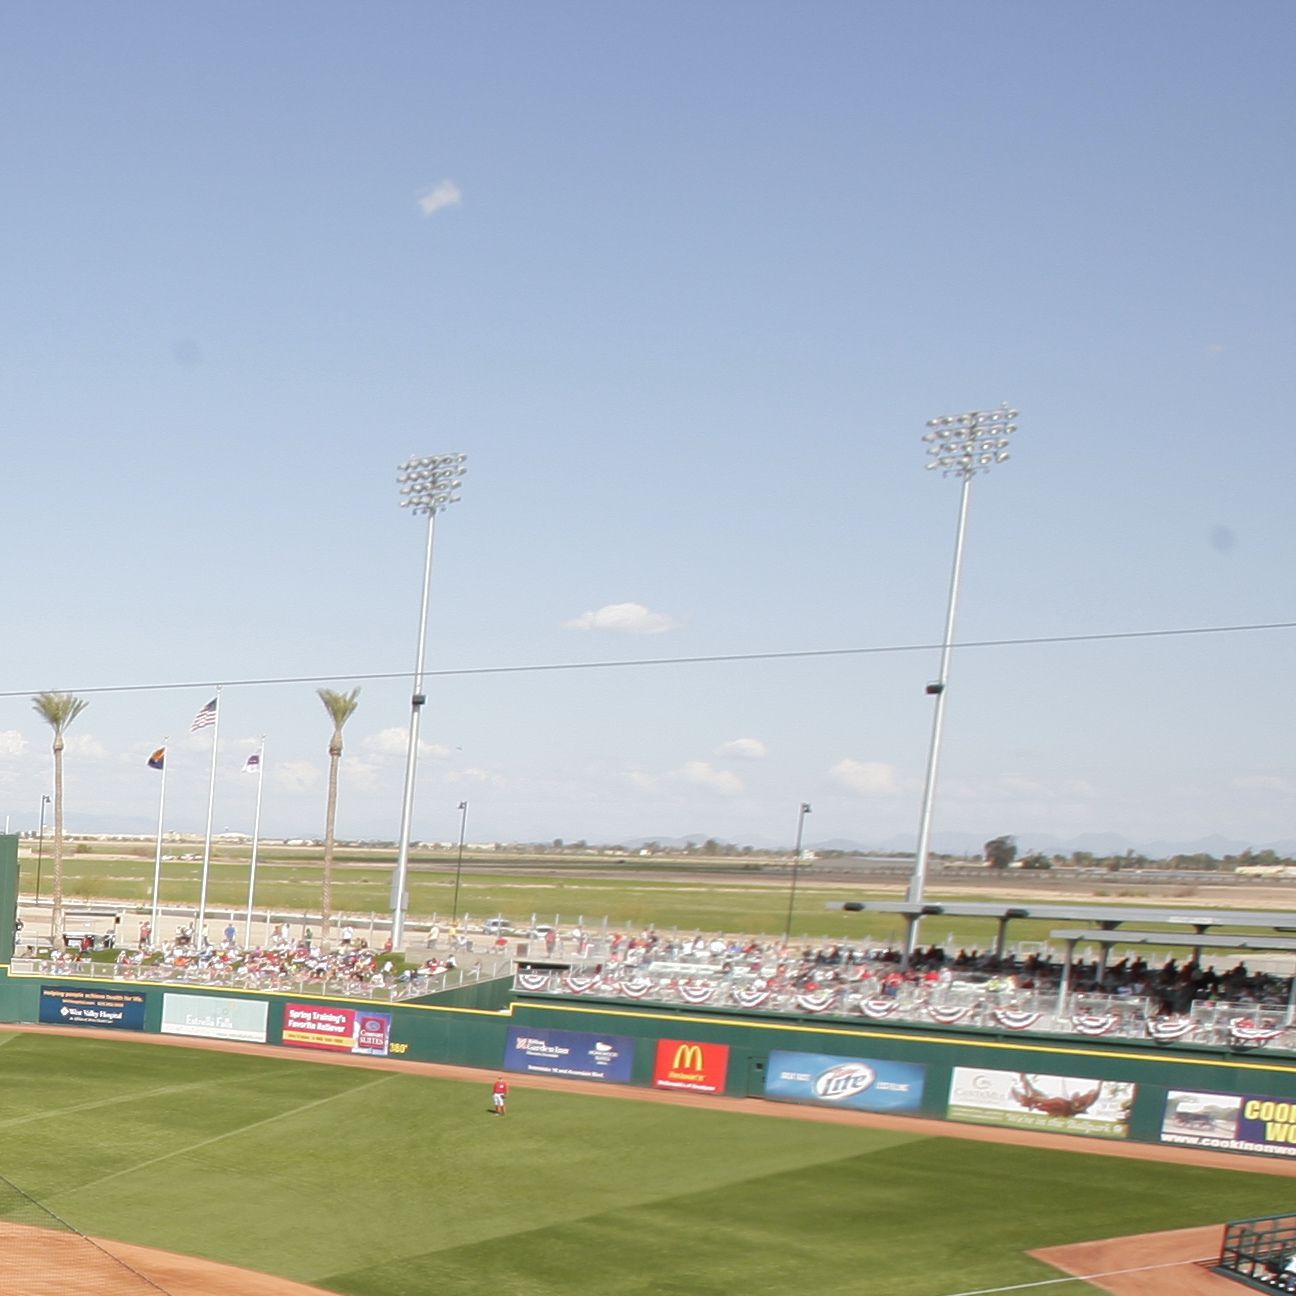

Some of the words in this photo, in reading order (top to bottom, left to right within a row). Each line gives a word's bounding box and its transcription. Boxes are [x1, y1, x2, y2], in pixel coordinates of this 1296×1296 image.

[69, 1008, 82, 1016] West
[83, 1010, 99, 1018] Valley
[100, 1010, 122, 1019] Hospital
[289, 1010, 311, 1020] Spring
[312, 1012, 346, 1023] Training's
[186, 1014, 215, 1027] Estrella
[216, 1016, 233, 1028] Falls
[288, 1020, 316, 1030] Favorite
[317, 1023, 346, 1032] Reliever
[360, 1036, 384, 1046] SUITES
[528, 1044, 554, 1053] Garden
[555, 1046, 570, 1054] Inn
[822, 1074, 868, 1096] Lite
